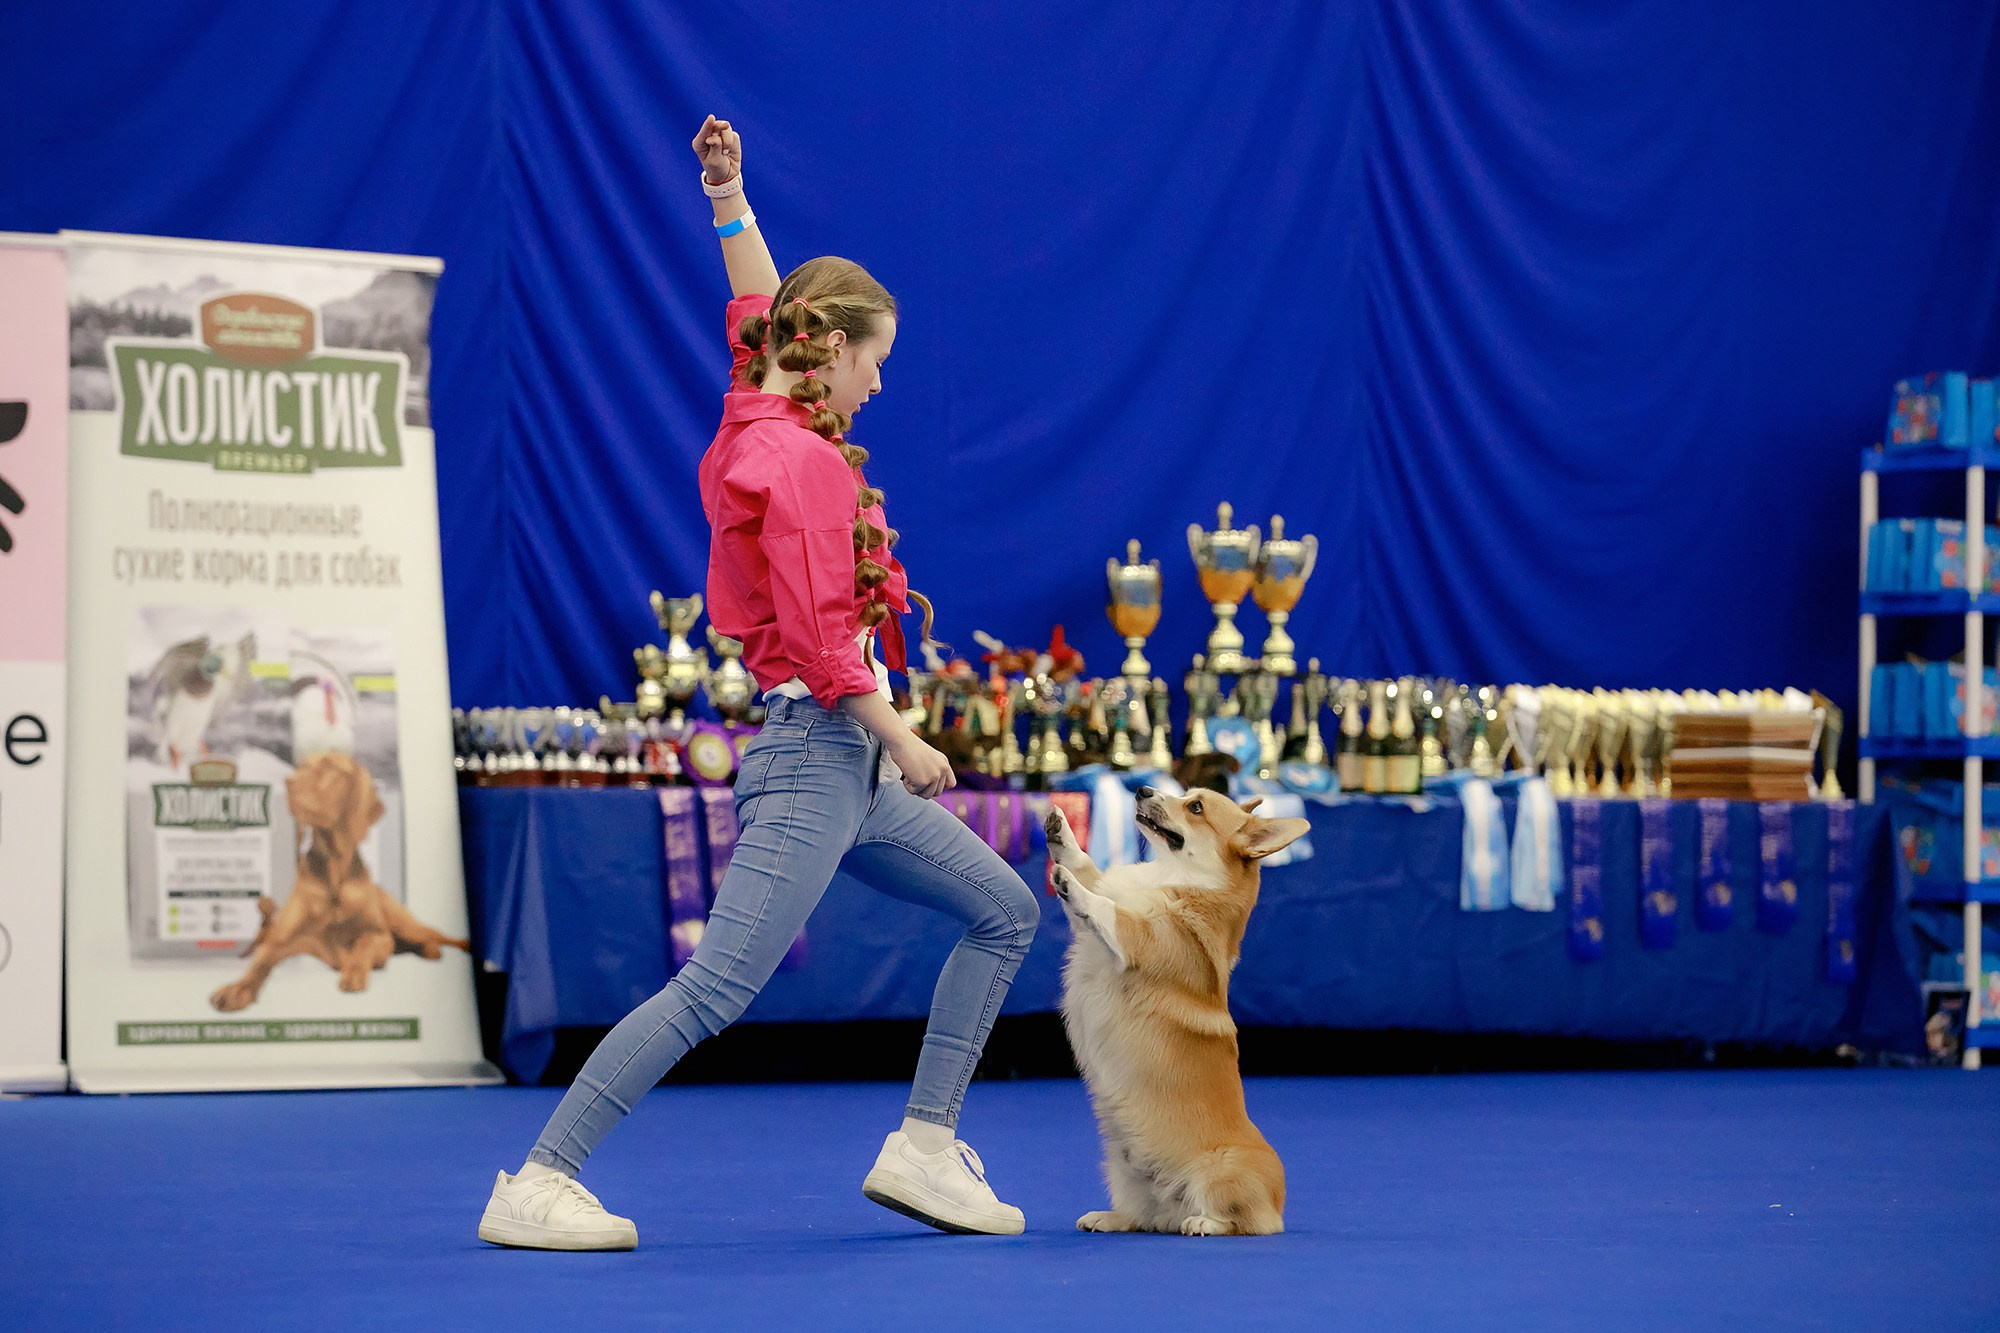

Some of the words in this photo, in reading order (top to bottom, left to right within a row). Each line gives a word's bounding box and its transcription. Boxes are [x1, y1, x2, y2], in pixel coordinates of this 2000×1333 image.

[135, 358, 387, 456] ХОЛИСТИК
[218, 450, 308, 470] ПРЕМЬЕР
[148, 489, 363, 538] Полнорационные
[113, 546, 184, 586] сухие
[192, 548, 268, 588] корма
[274, 551, 322, 588] для
[330, 545, 402, 588] собак
